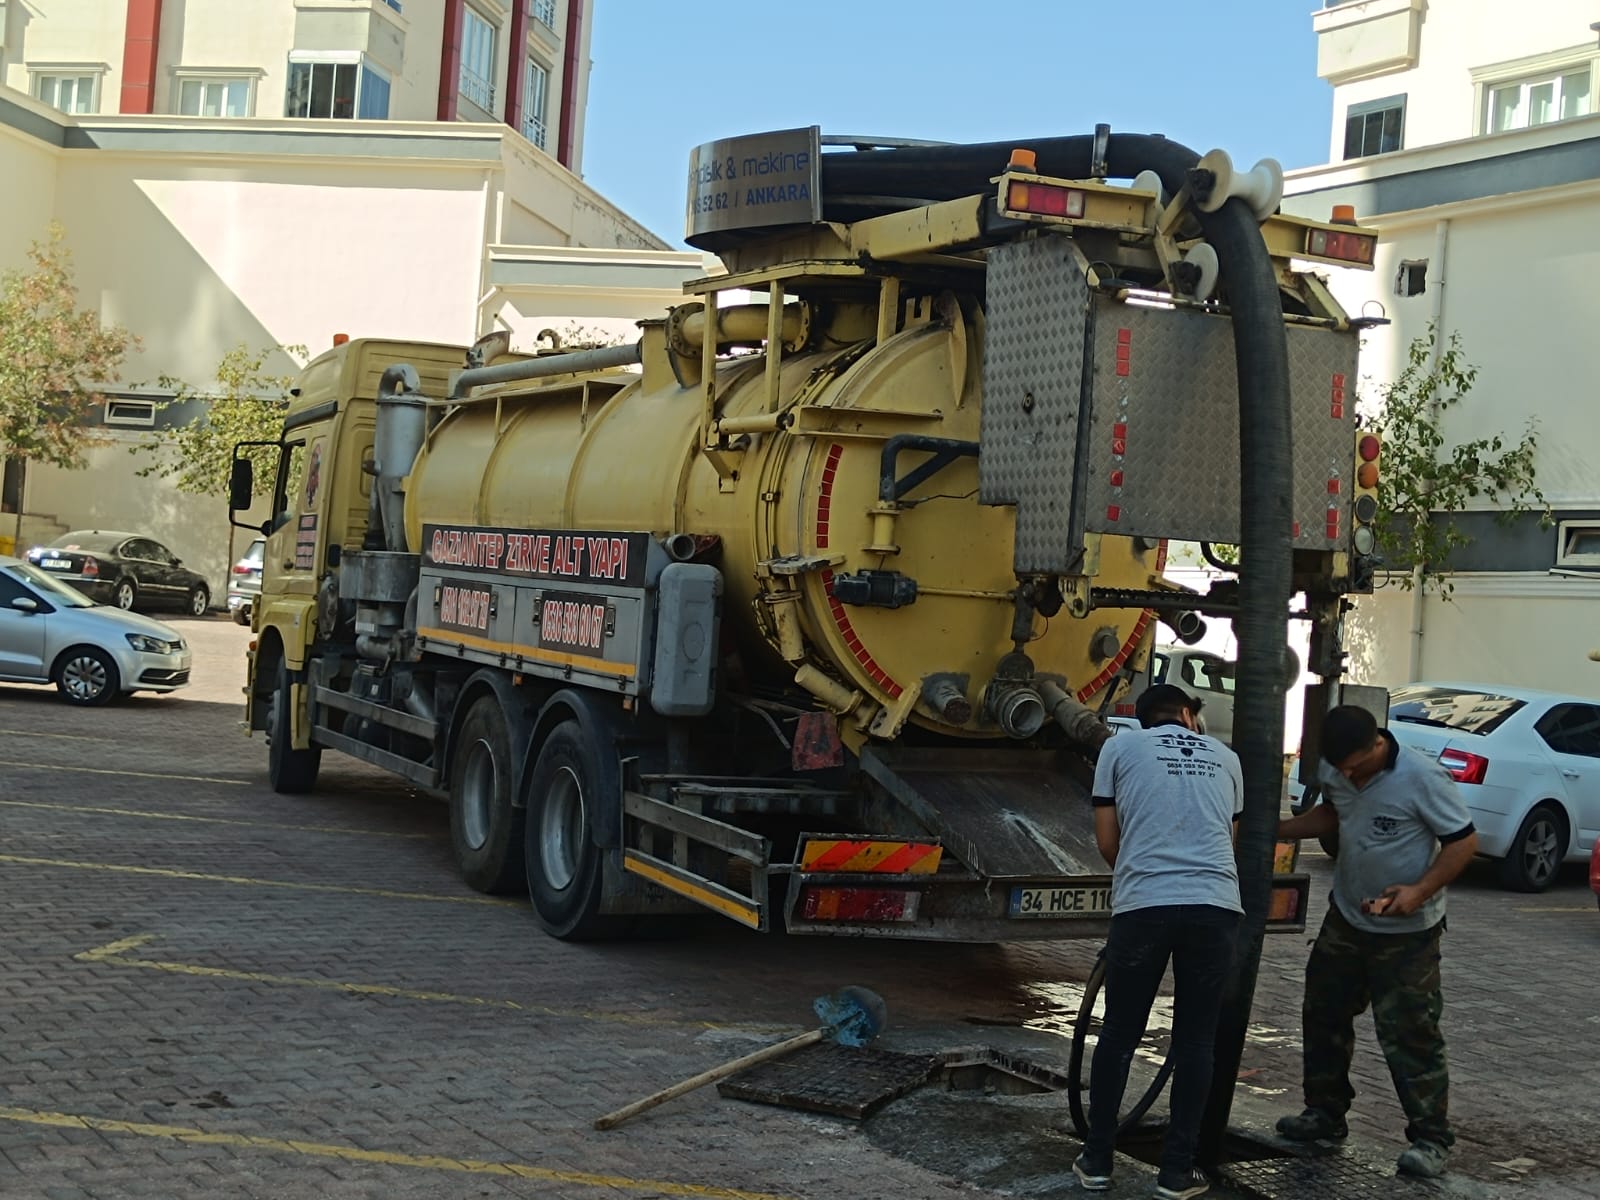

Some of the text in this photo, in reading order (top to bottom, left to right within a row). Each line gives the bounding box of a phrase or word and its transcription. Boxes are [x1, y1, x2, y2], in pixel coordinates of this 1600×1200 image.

[726, 156, 737, 180] &
[743, 151, 809, 177] makine
[703, 195, 713, 212] 52
[716, 192, 728, 210] 62
[746, 183, 809, 206] ANKARA
[552, 536, 585, 576] ALT
[588, 537, 629, 580] YAPI
[562, 601, 579, 645] 593
[591, 604, 604, 649] 67
[1021, 891, 1043, 912] 34
[1050, 890, 1085, 911] HCE
